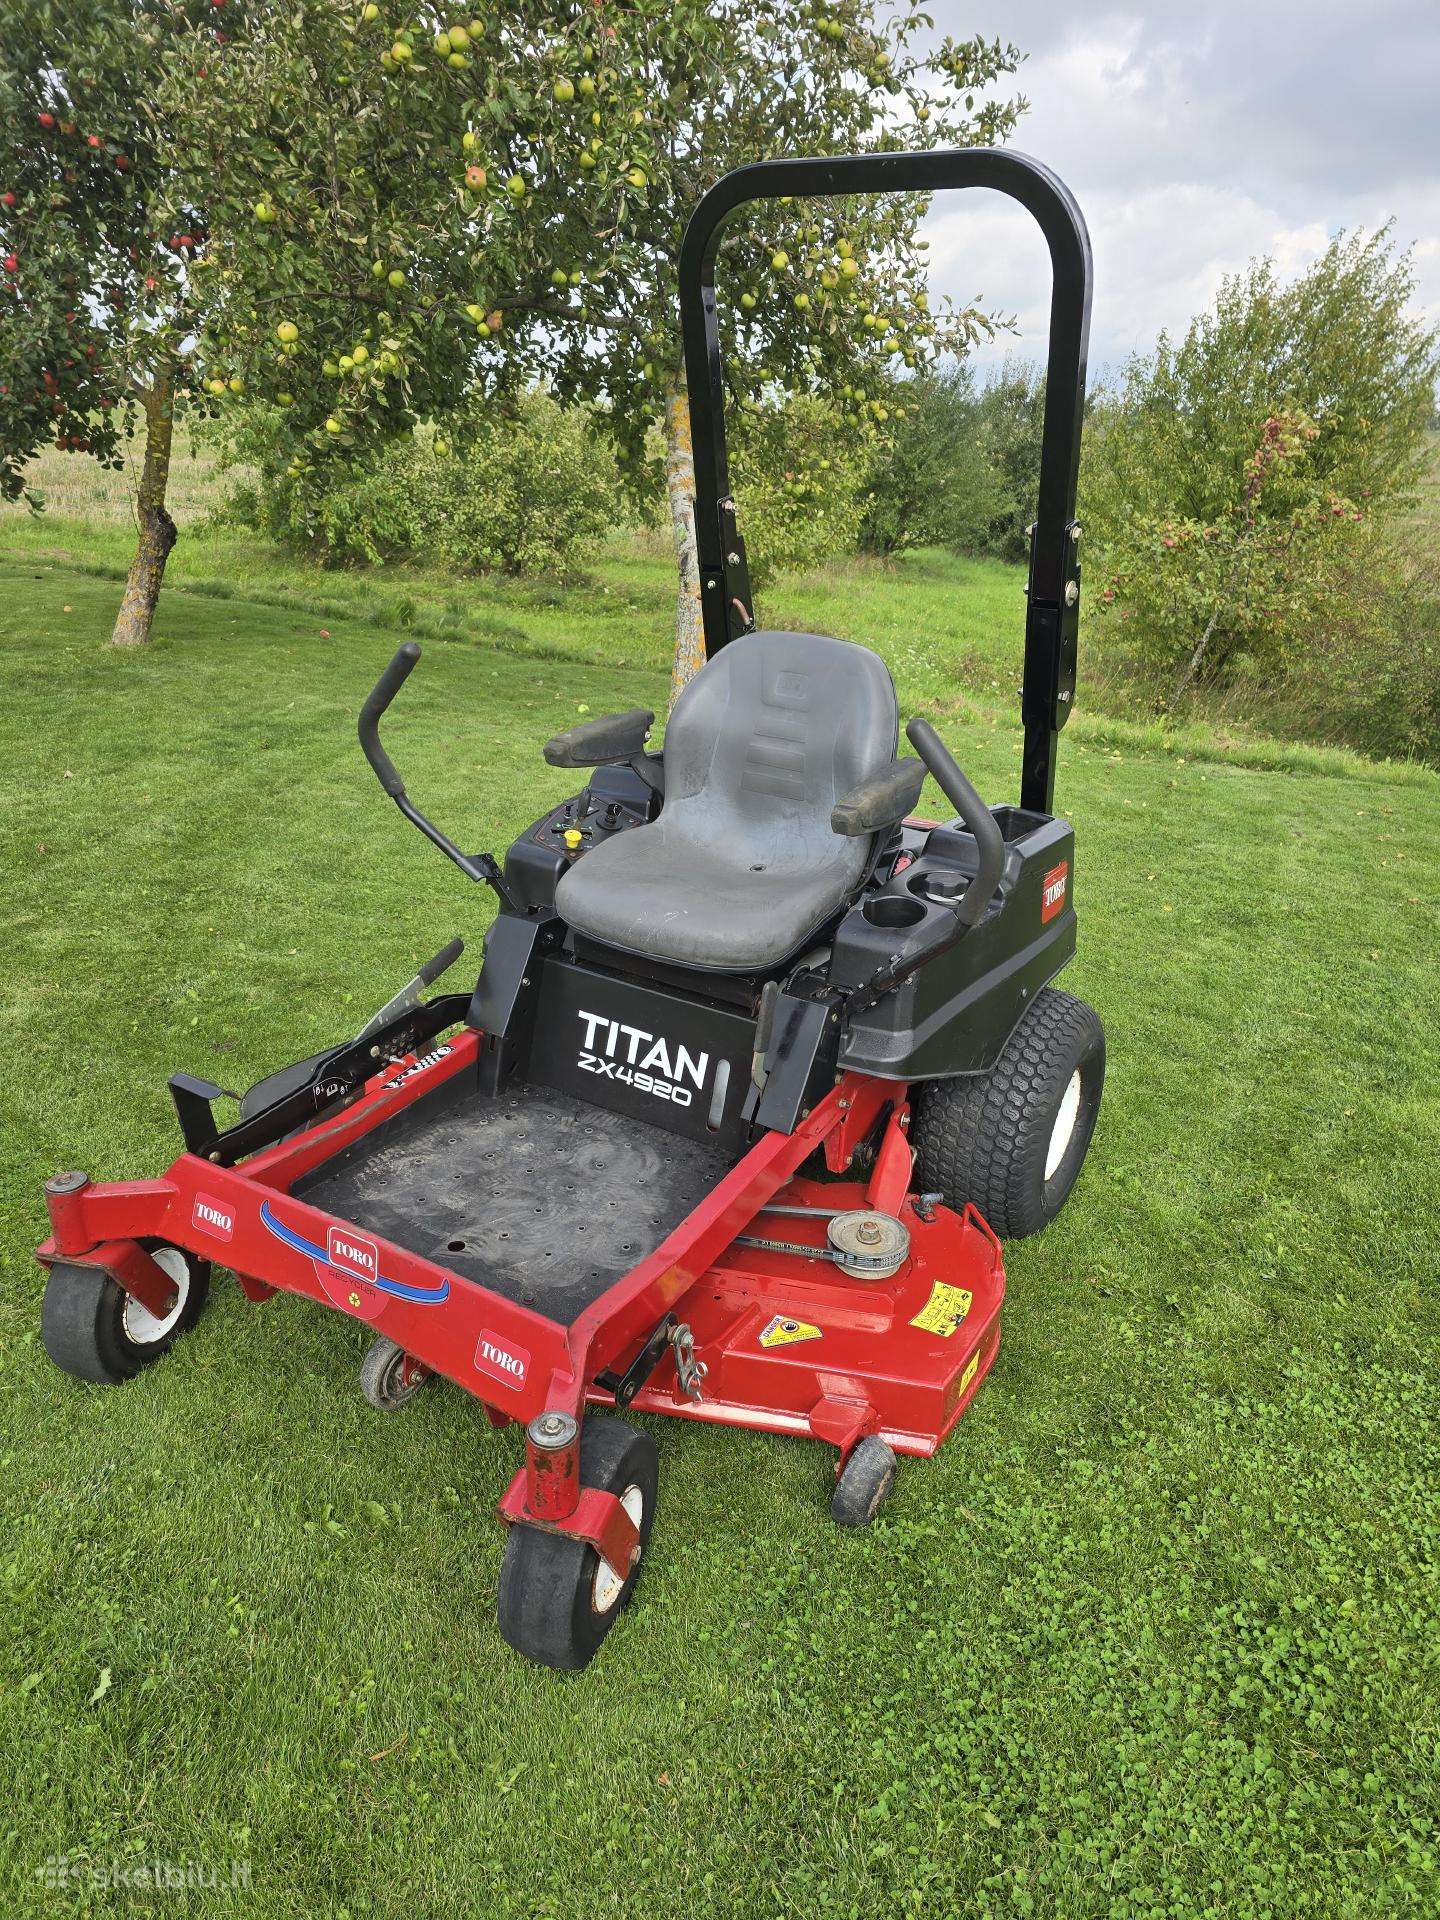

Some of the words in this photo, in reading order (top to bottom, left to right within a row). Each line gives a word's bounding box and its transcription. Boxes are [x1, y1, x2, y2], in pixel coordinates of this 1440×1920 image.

[578, 1009, 709, 1090] TITAN
[577, 1051, 693, 1107] ZX4920
[196, 1202, 232, 1230] TORO
[333, 1239, 373, 1268] TORO
[481, 1340, 524, 1376] TORO
